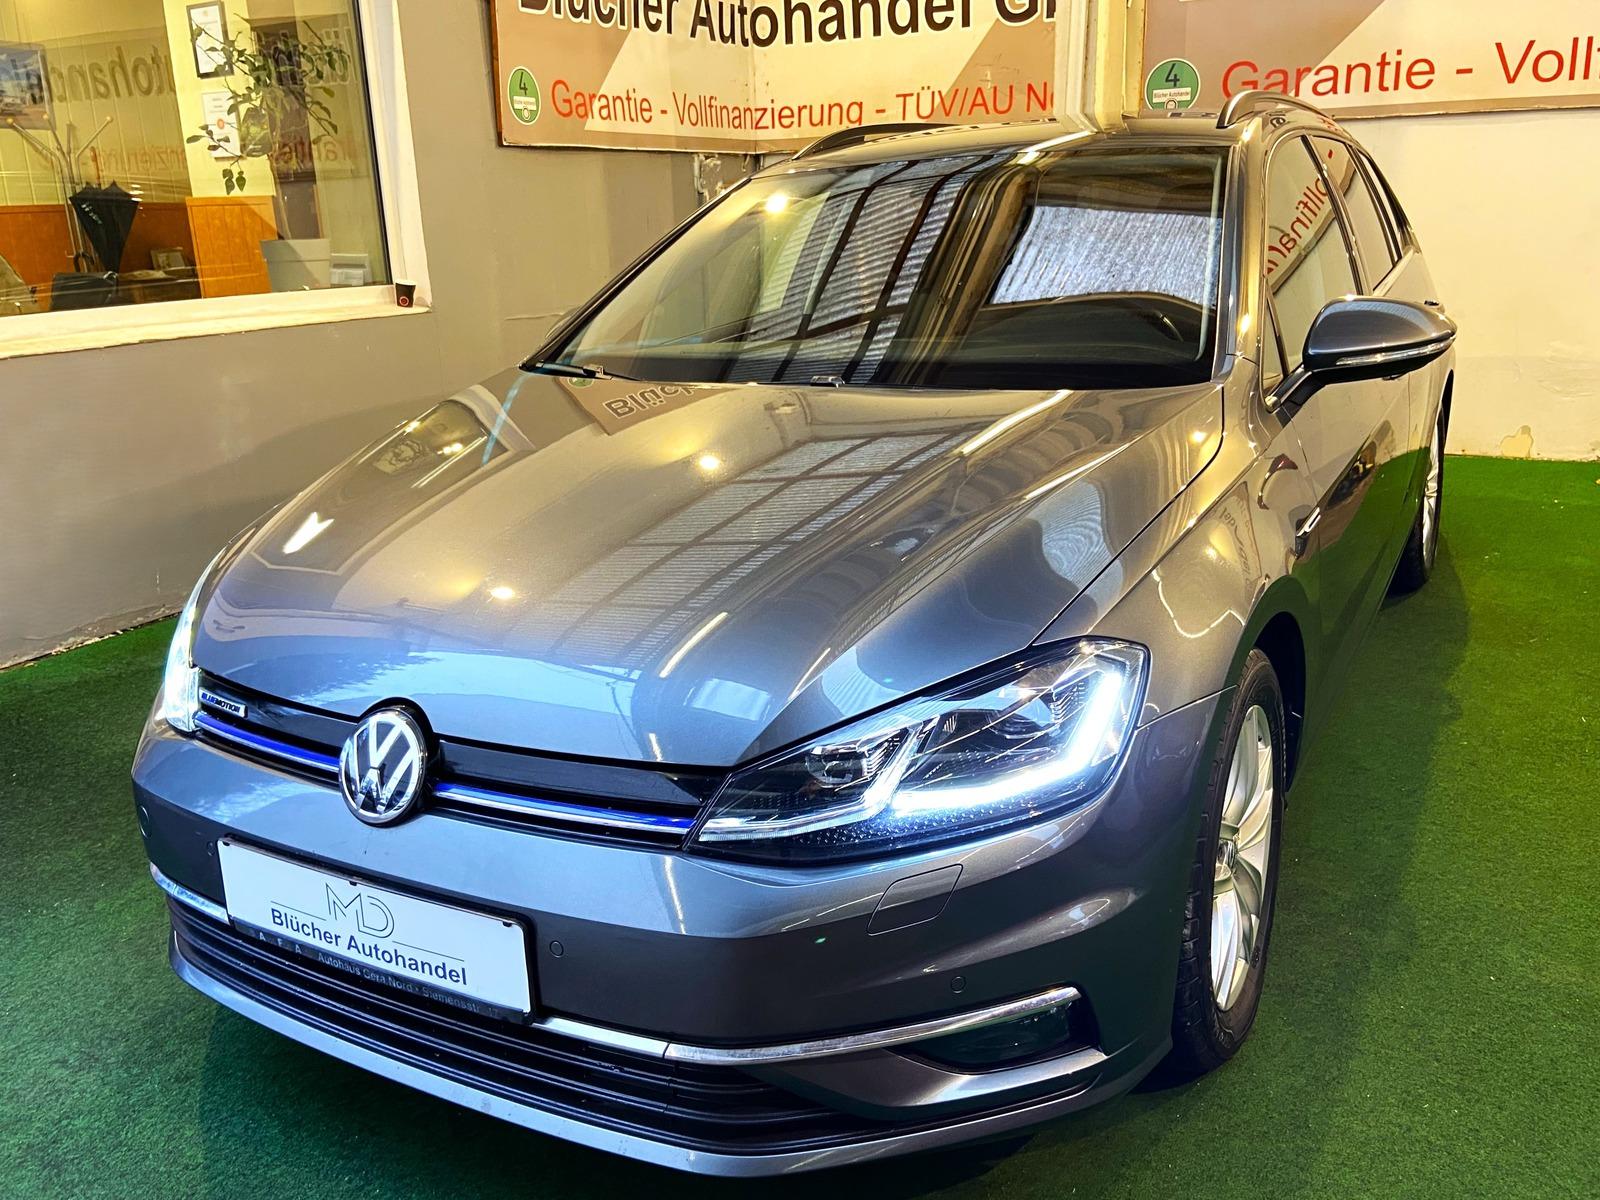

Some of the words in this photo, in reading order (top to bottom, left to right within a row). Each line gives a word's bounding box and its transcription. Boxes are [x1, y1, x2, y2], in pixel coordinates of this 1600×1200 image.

[519, 0, 678, 35] cher
[690, 0, 970, 47] Autohandel
[519, 71, 528, 96] 4
[1165, 63, 1180, 87] 4
[1222, 49, 1436, 99] Garantie
[1495, 36, 1600, 84] Voll
[552, 79, 653, 124] Garantie
[672, 91, 864, 130] Vollfinanzierung
[896, 84, 1013, 121] TÜV/AU
[1026, 81, 1054, 113] N
[271, 907, 341, 946] Blücher
[347, 935, 467, 985] Autohandel
[318, 953, 360, 976] Autohaus
